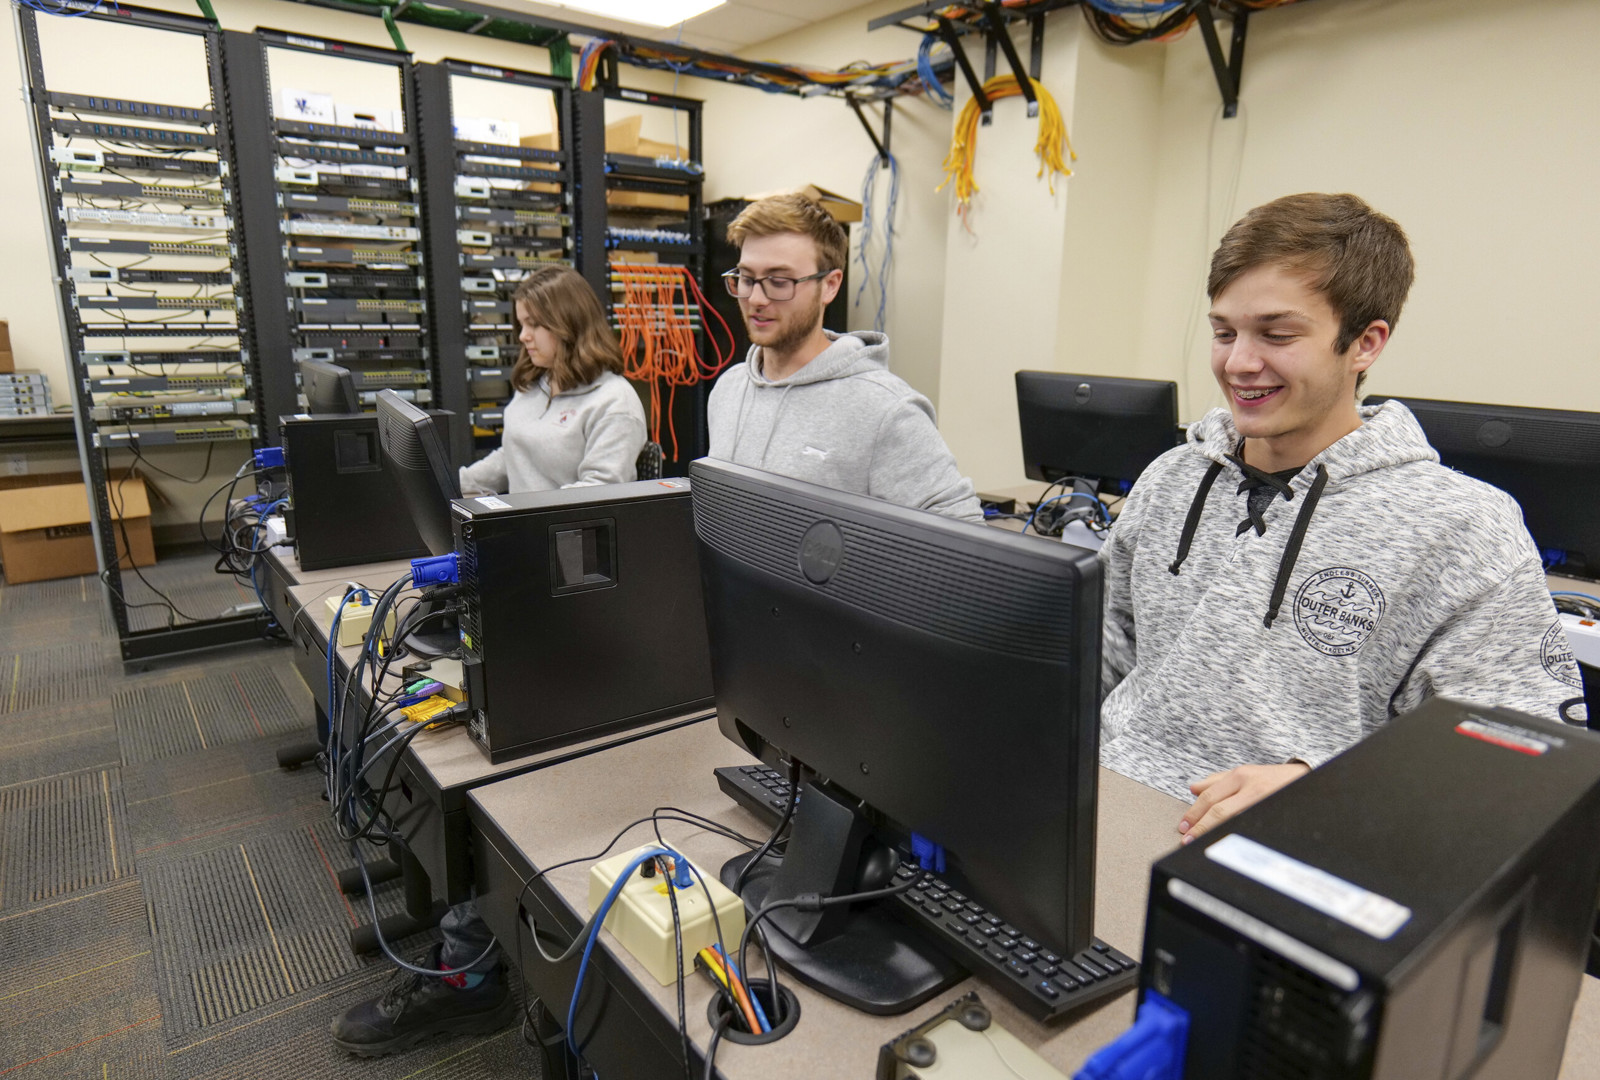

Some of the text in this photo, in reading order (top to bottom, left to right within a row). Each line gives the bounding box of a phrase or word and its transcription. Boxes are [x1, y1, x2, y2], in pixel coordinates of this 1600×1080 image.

[1319, 570, 1380, 599] ENDLESS SUMMER
[1301, 597, 1375, 631] OUTER BANKS
[1301, 627, 1356, 654] NORTH CAROLINA
[1547, 651, 1574, 665] OUTE
